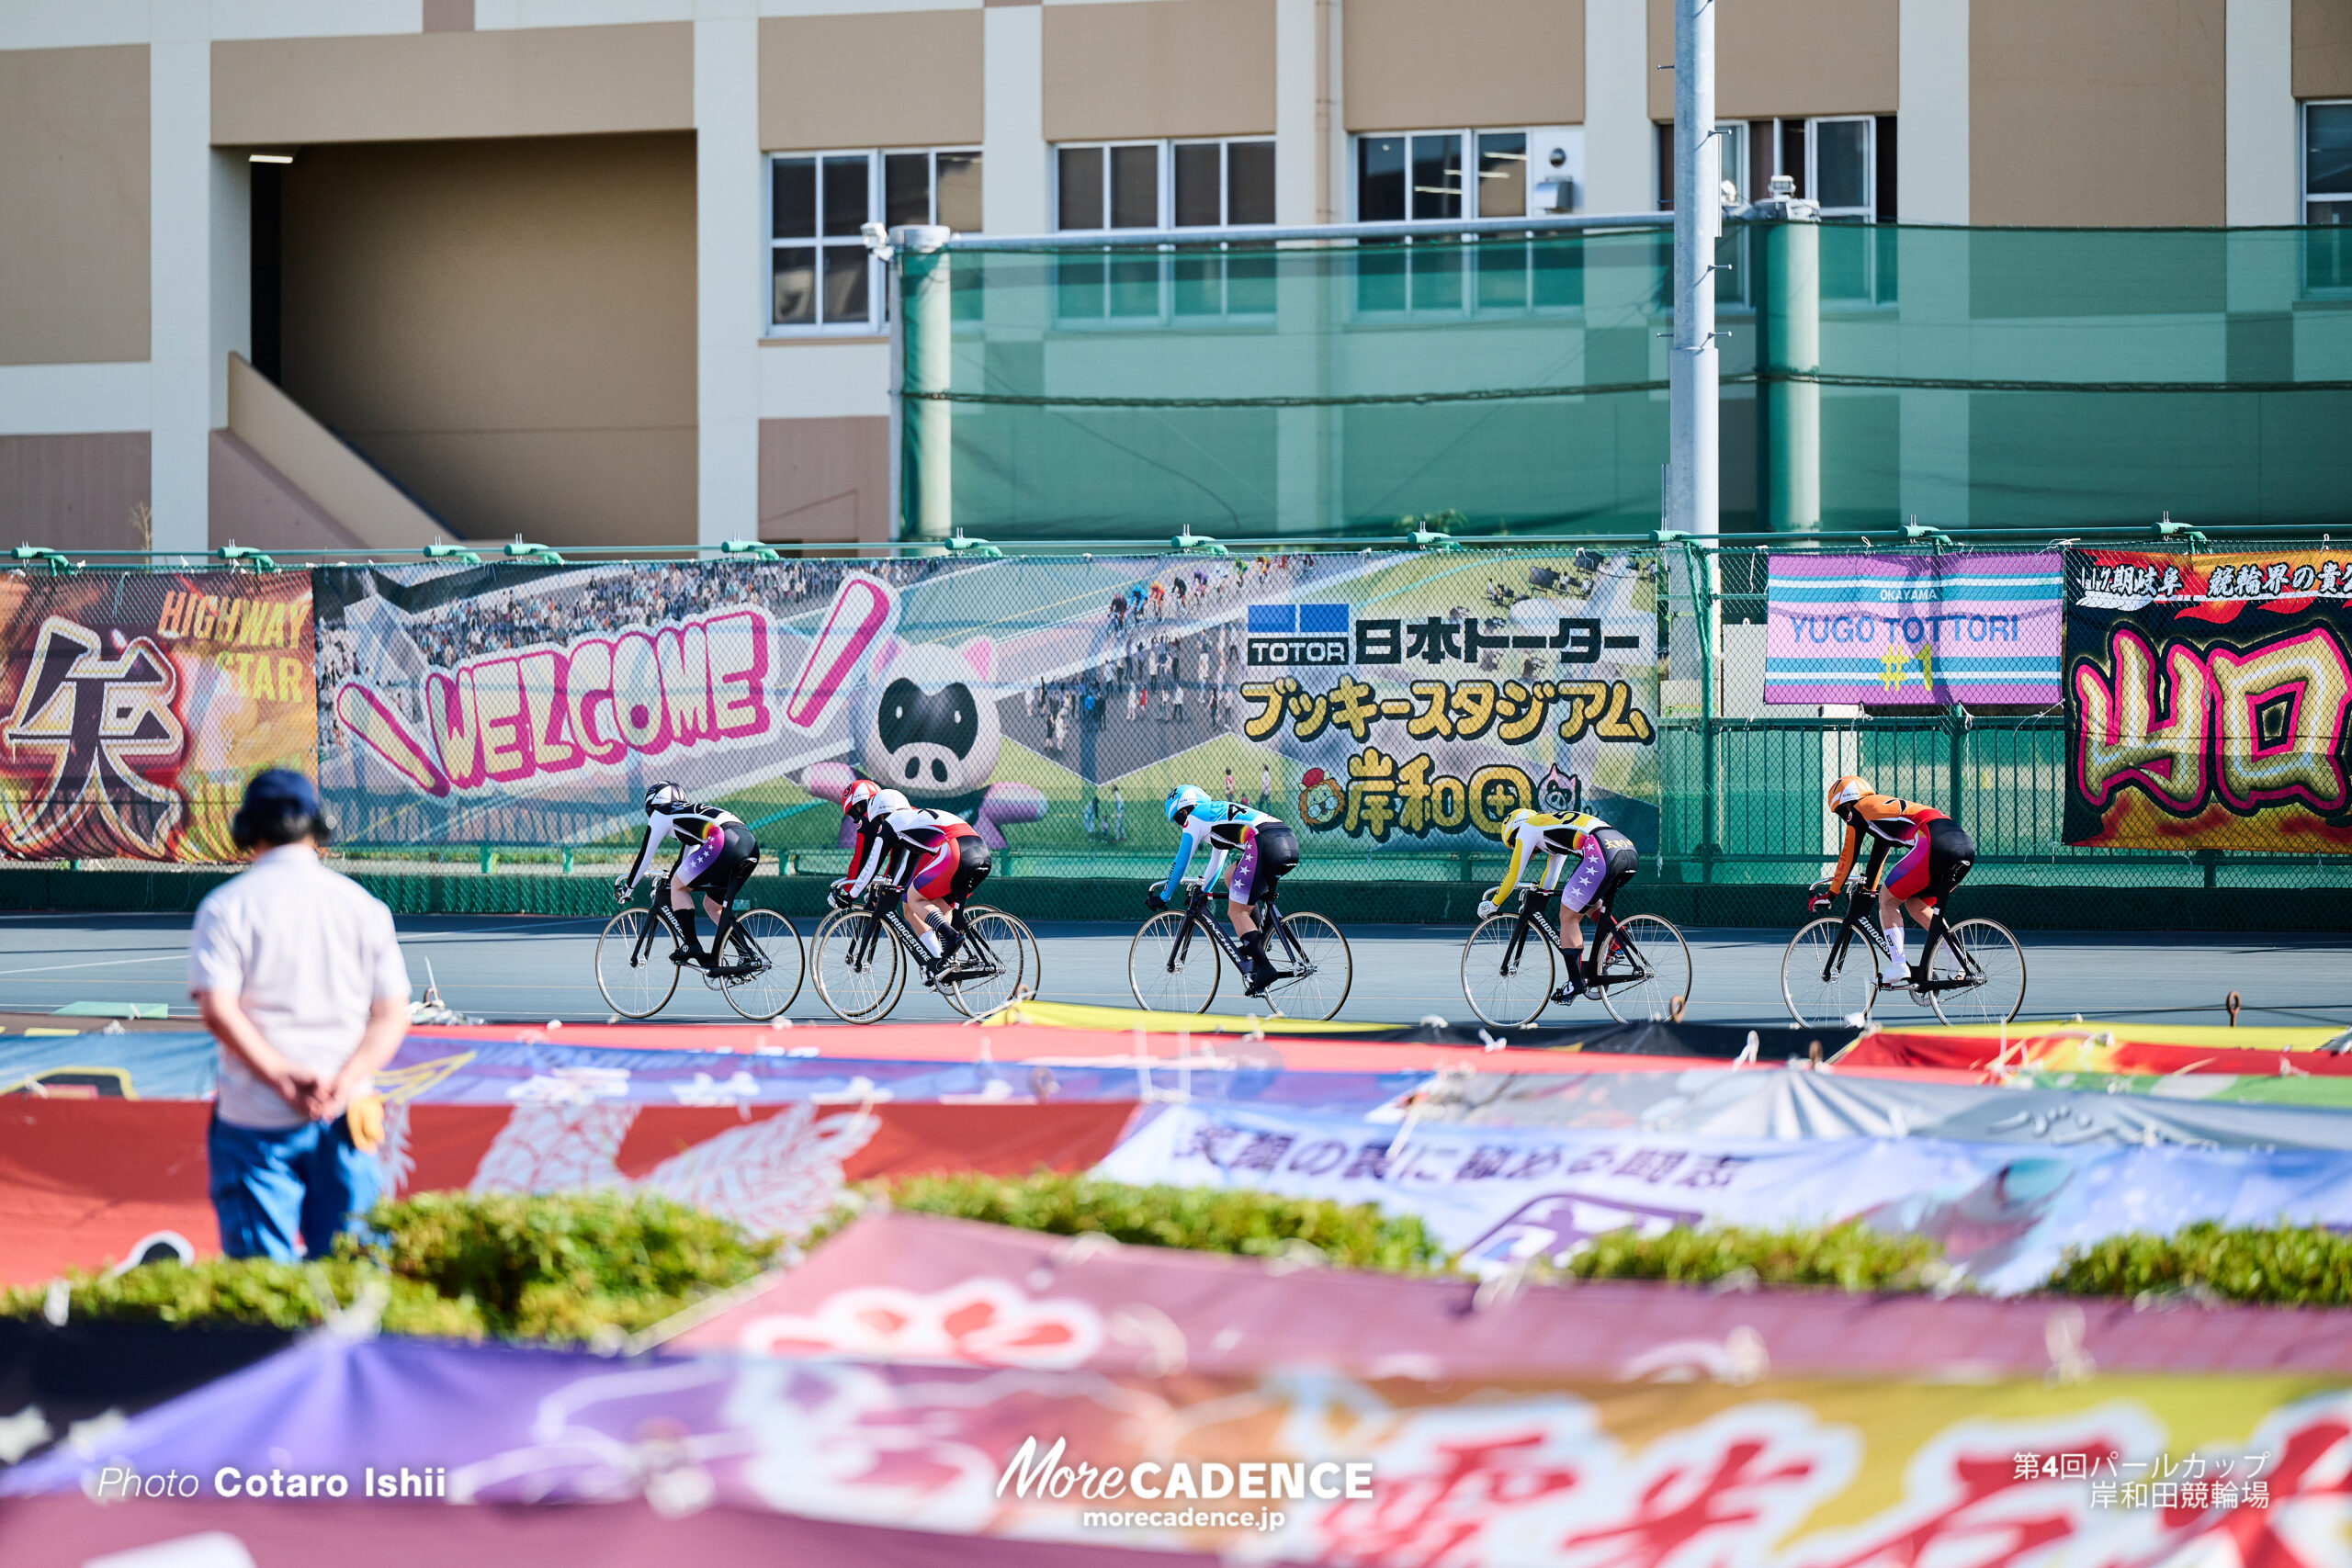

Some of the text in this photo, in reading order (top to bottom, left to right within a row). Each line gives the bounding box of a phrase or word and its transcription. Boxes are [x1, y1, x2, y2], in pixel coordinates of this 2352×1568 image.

[1880, 589, 1938, 601] OKAYAMA
[157, 591, 311, 649] HIGHWAY
[1355, 616, 1640, 665] 日本トーター
[1791, 615, 2018, 643] YUGO TOTTORI
[1251, 642, 1345, 662] TOTOR
[1878, 643, 1934, 692] #1
[214, 650, 304, 704] STAR
[1240, 673, 1657, 746] ブッキースタジアム
[2075, 627, 2352, 811] 山口
[1227, 804, 1249, 821] 4
[1347, 746, 1537, 843] 岸和田
[1553, 810, 1580, 825] 5
[1882, 798, 1907, 815] 7
[885, 910, 932, 963] BRIDGESTONE
[1202, 913, 1241, 963] ANCHOR
